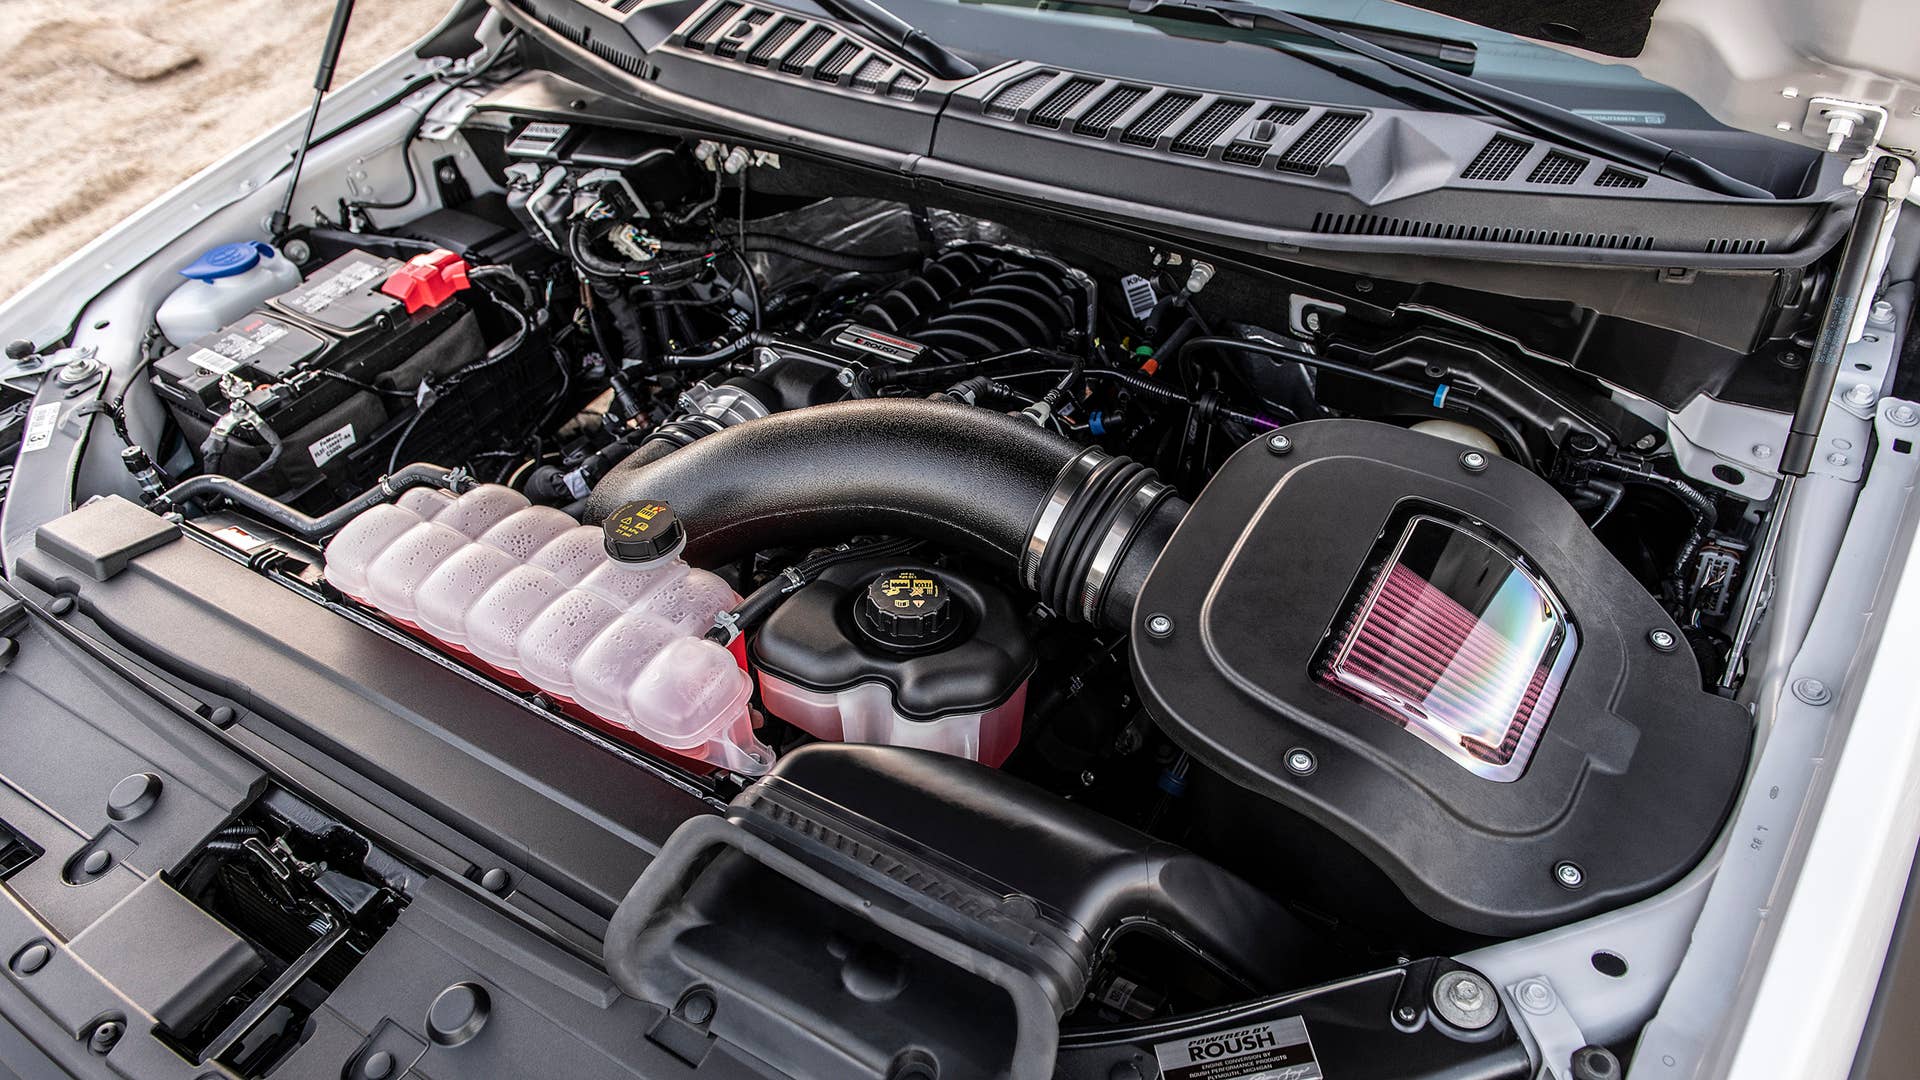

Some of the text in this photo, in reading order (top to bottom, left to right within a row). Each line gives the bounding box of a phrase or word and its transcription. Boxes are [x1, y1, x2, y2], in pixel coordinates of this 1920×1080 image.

[863, 341, 898, 355] ROUSH
[1188, 1025, 1270, 1047] POWERED BY
[1188, 1031, 1276, 1062] ROUSH
[1189, 1070, 1210, 1079] ROUSH
[1211, 1061, 1255, 1075] PERFORMANCE
[1255, 1054, 1288, 1066] PRODUCTS
[1201, 1061, 1224, 1070] ENGINE
[1224, 1054, 1262, 1066] CONVERSION
[1242, 1063, 1273, 1074] MICHIGAN
